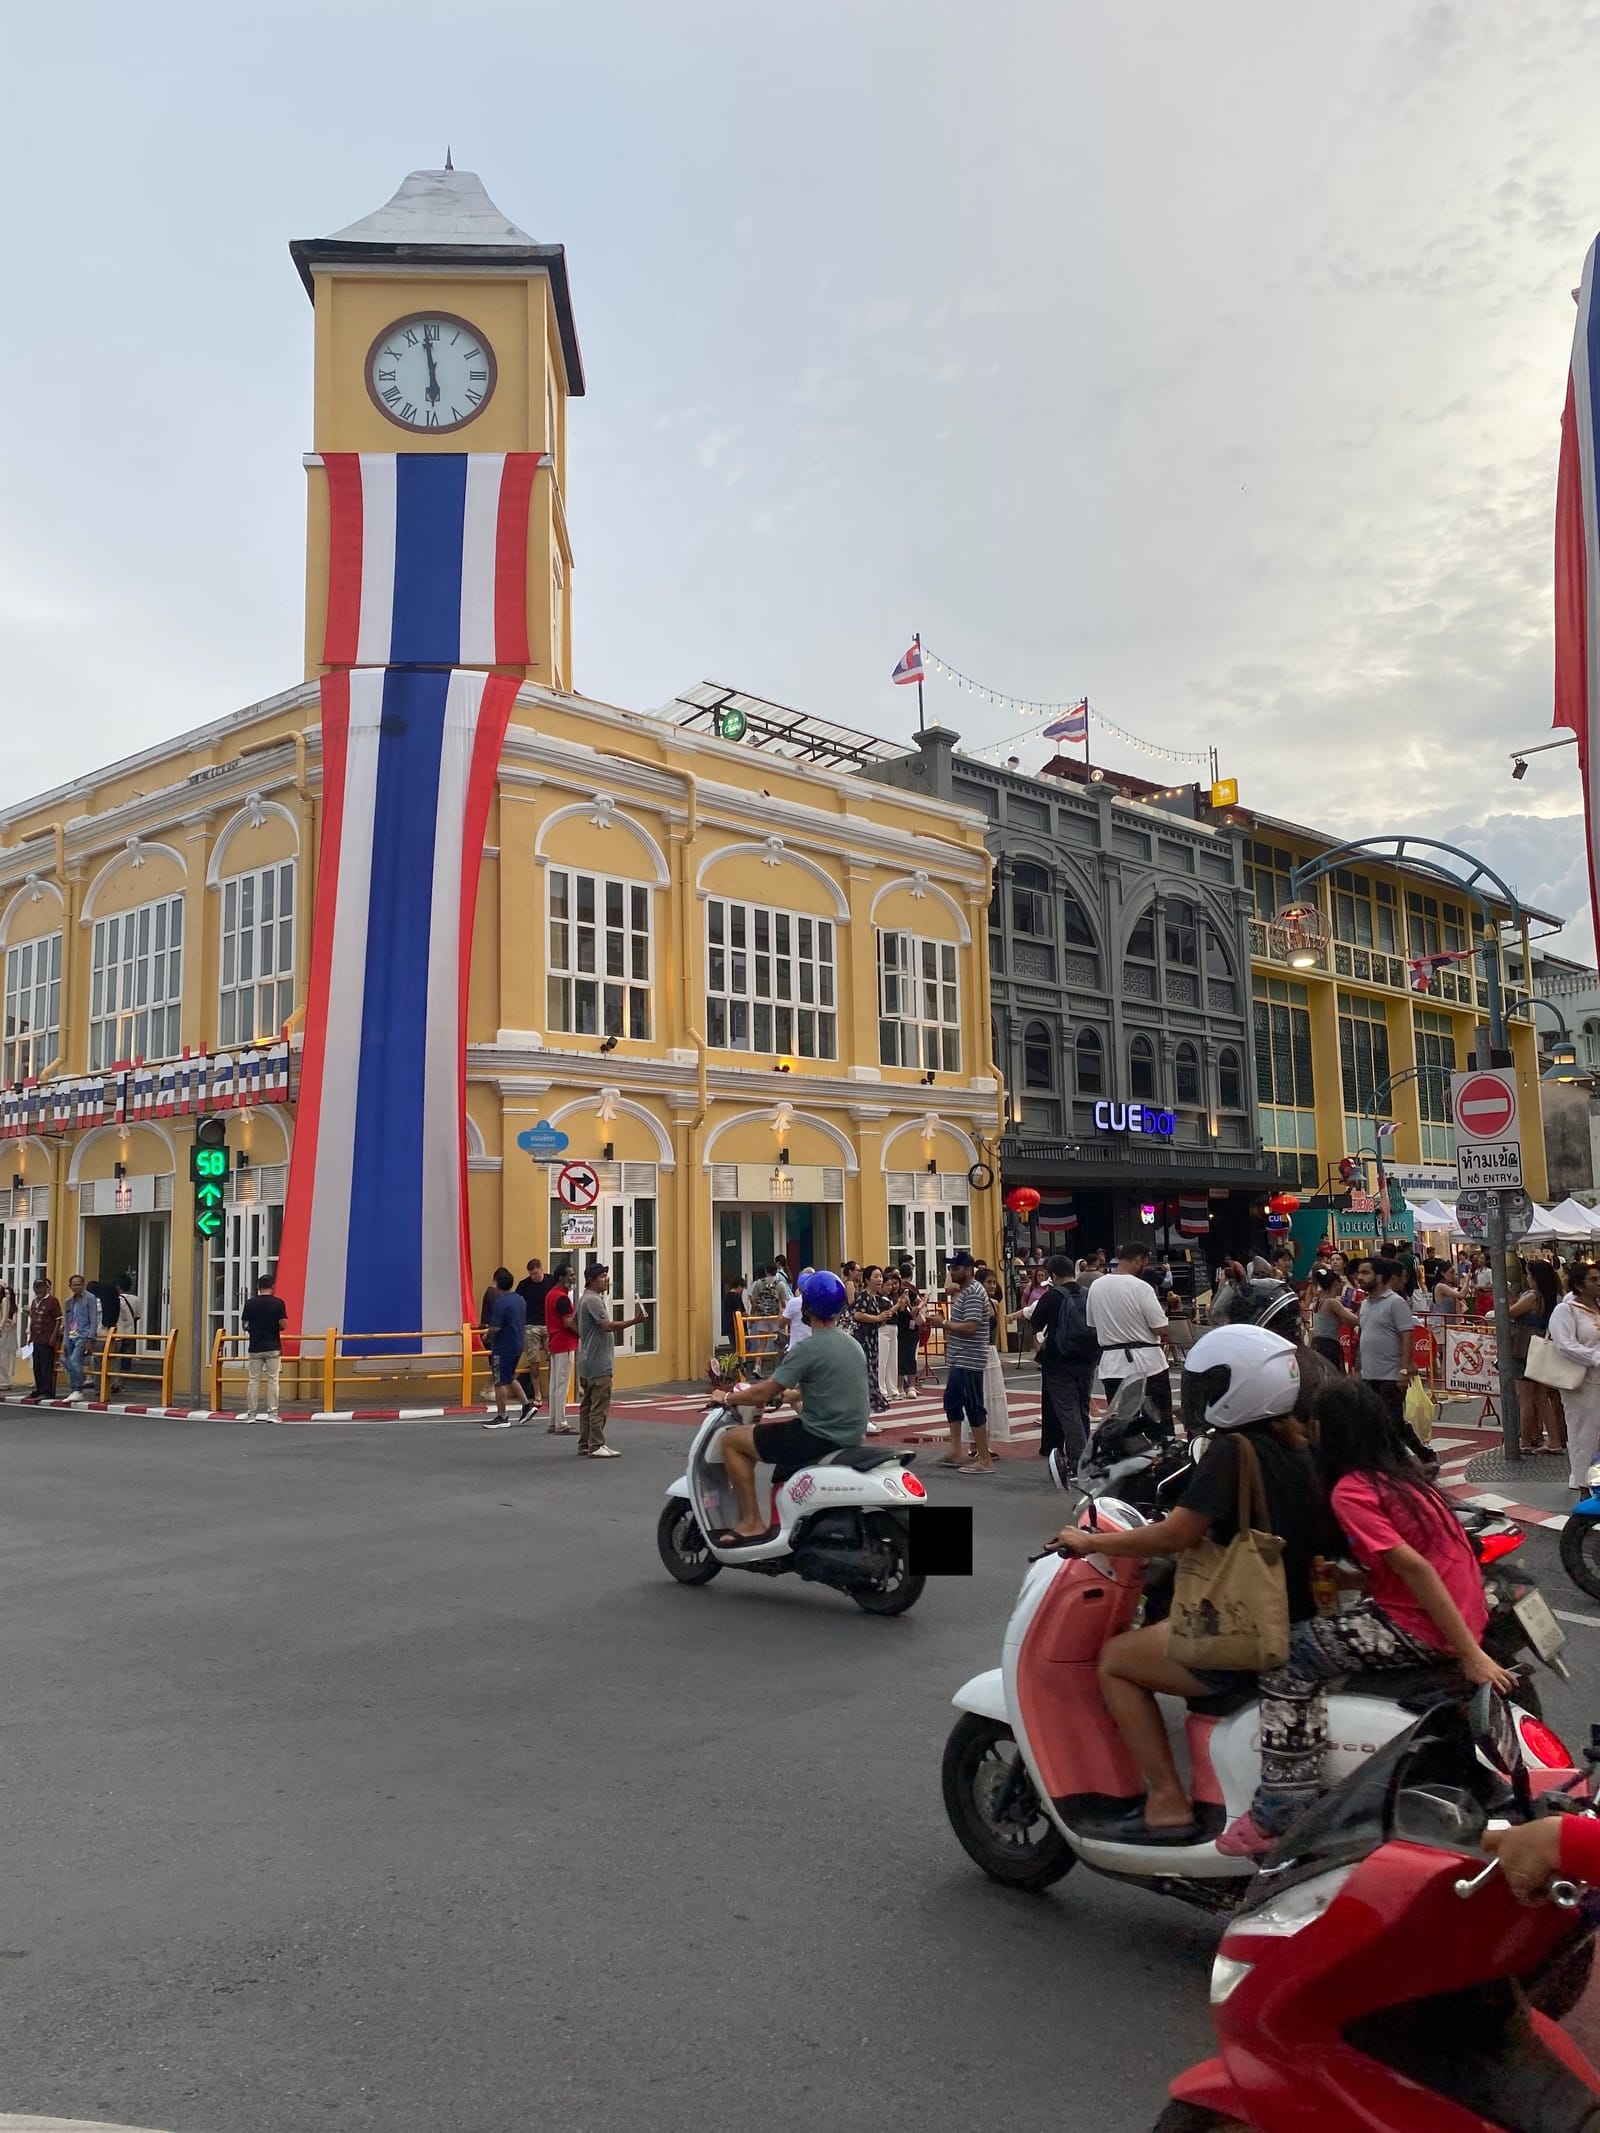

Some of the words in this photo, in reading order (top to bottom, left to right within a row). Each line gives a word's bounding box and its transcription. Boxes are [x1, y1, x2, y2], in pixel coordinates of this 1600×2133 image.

[22, 1076, 104, 1136] From
[111, 1026, 289, 1124] Thailand
[197, 1151, 225, 1175] 58
[1467, 1174, 1480, 1185] NO
[1483, 1173, 1512, 1183] ENTRY
[1351, 1221, 1361, 1232] ICE
[1385, 1222, 1407, 1232] ELATO
